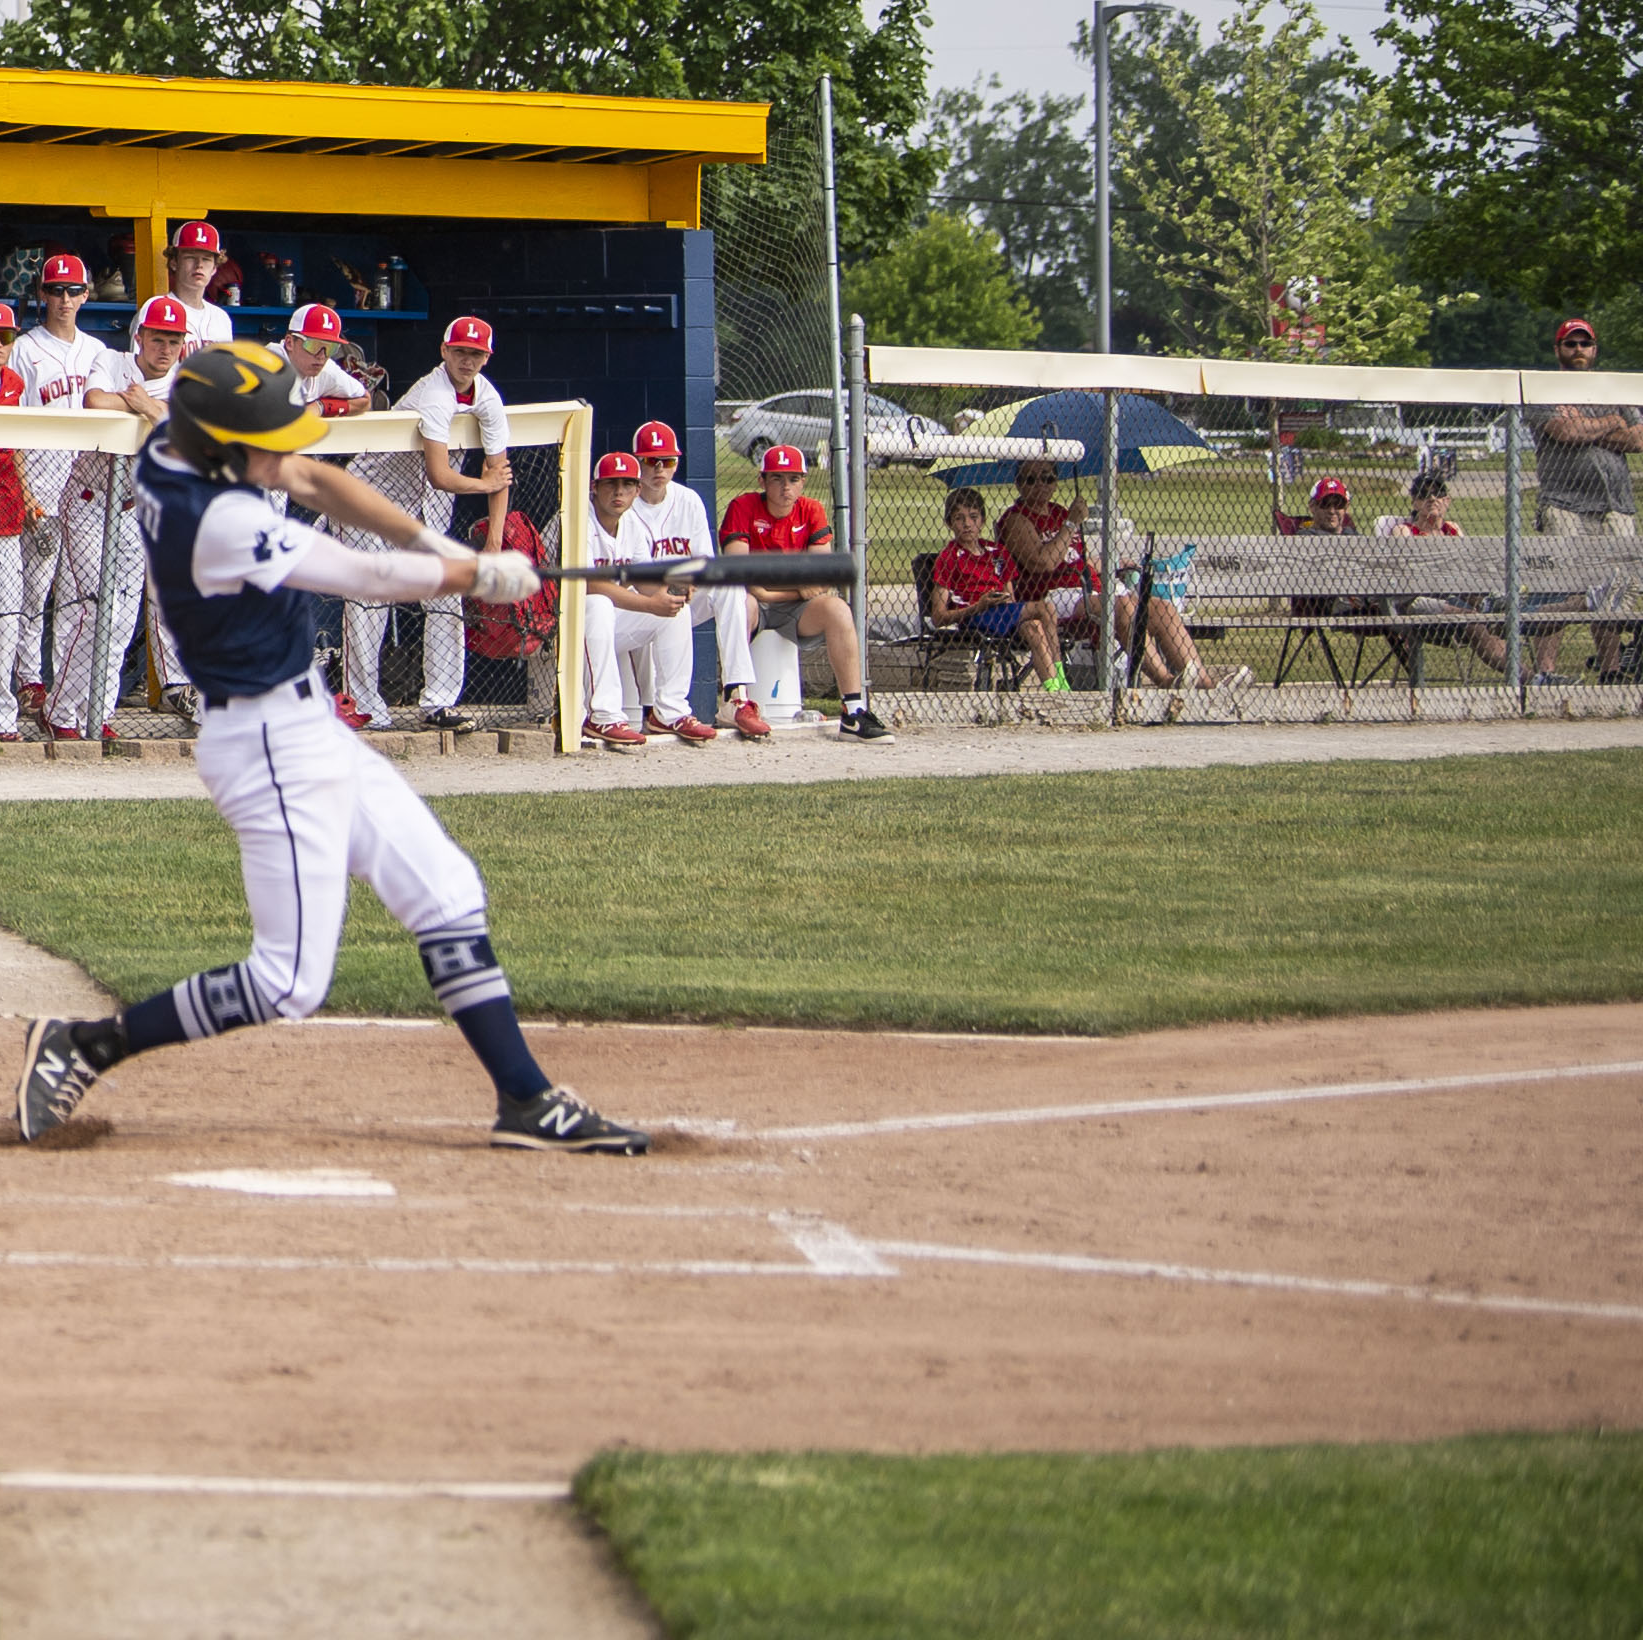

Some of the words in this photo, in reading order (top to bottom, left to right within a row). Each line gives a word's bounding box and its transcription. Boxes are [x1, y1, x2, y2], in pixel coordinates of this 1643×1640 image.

[195, 228, 208, 243] L
[57, 260, 69, 274] L
[164, 305, 176, 322] L
[322, 313, 334, 330] L
[466, 323, 479, 339] L
[651, 431, 663, 447] L
[615, 457, 627, 471] L
[777, 451, 790, 466] L
[36, 1047, 66, 1089] N
[538, 1103, 583, 1137] N
